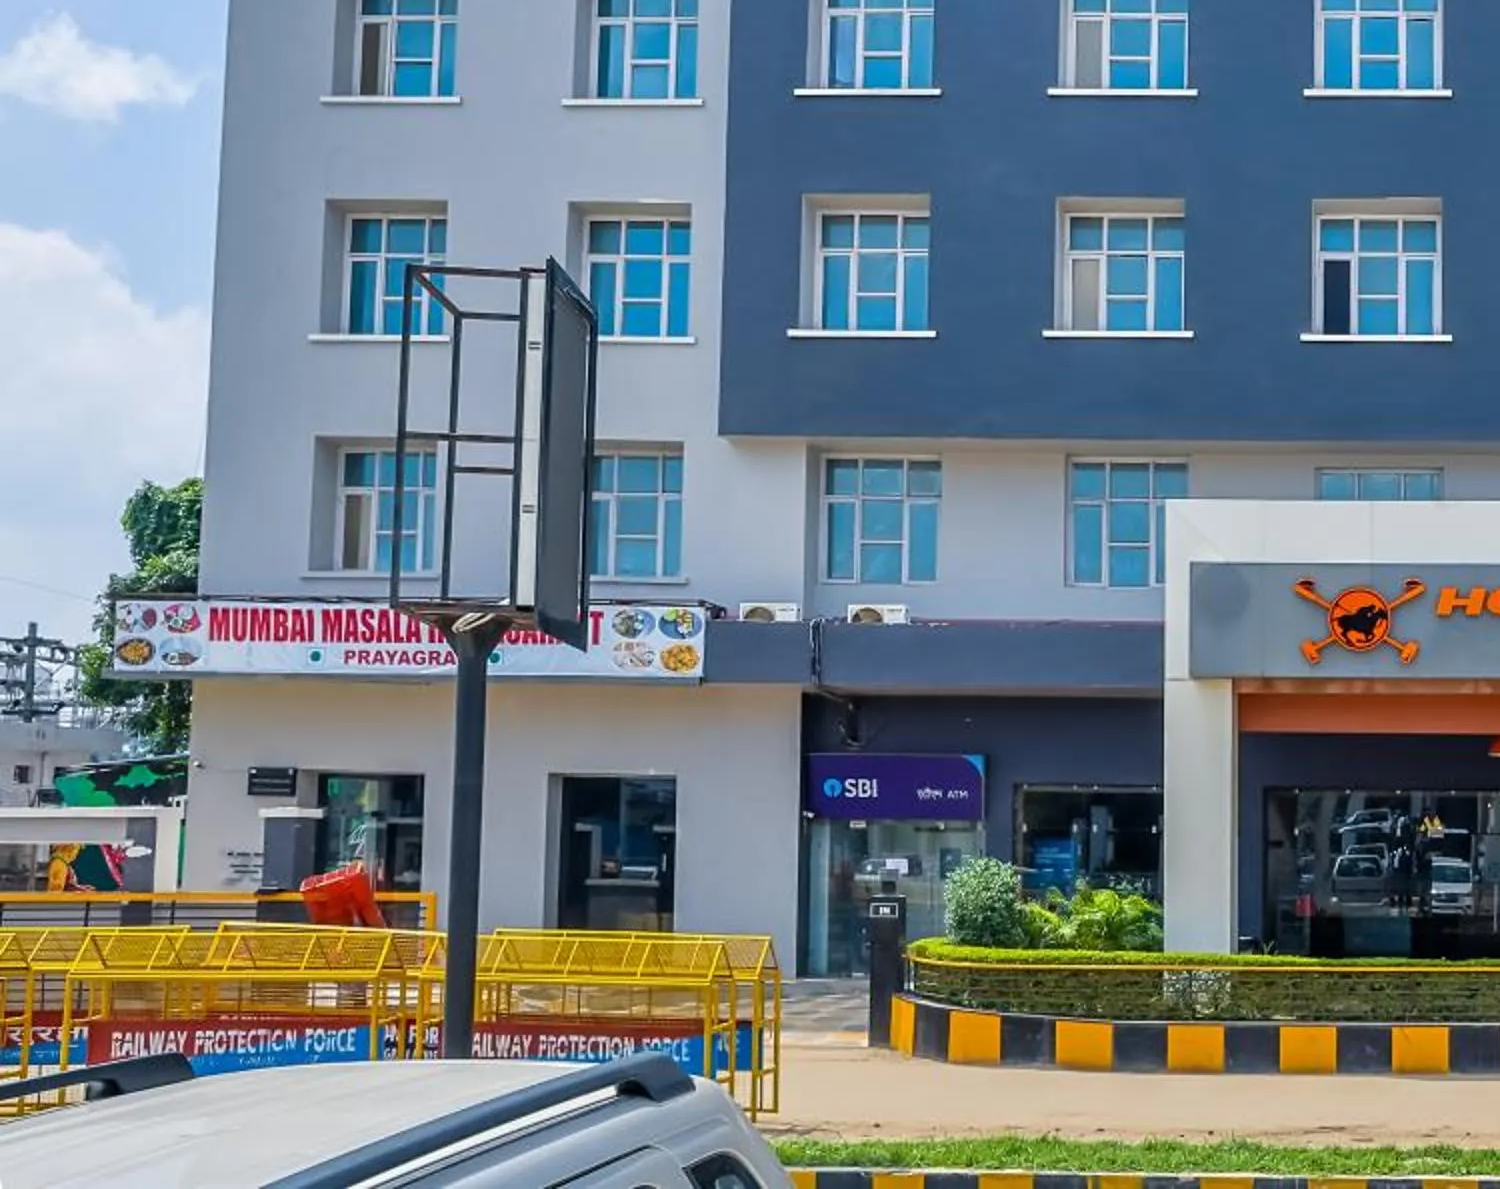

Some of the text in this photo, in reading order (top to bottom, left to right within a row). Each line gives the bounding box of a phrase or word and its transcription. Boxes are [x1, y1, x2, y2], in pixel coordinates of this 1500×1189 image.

[209, 607, 315, 643] MUMBAI
[322, 609, 421, 644] MASALA
[344, 649, 458, 666] PRAYAGRA
[844, 778, 878, 798] SBI
[947, 789, 969, 800] ATM
[111, 1031, 187, 1058] RAILWAY
[193, 1028, 298, 1054] PROTECTION
[304, 1027, 357, 1052] FORCE
[471, 1032, 532, 1058] AILWAY
[538, 1035, 635, 1059] PROTECTION
